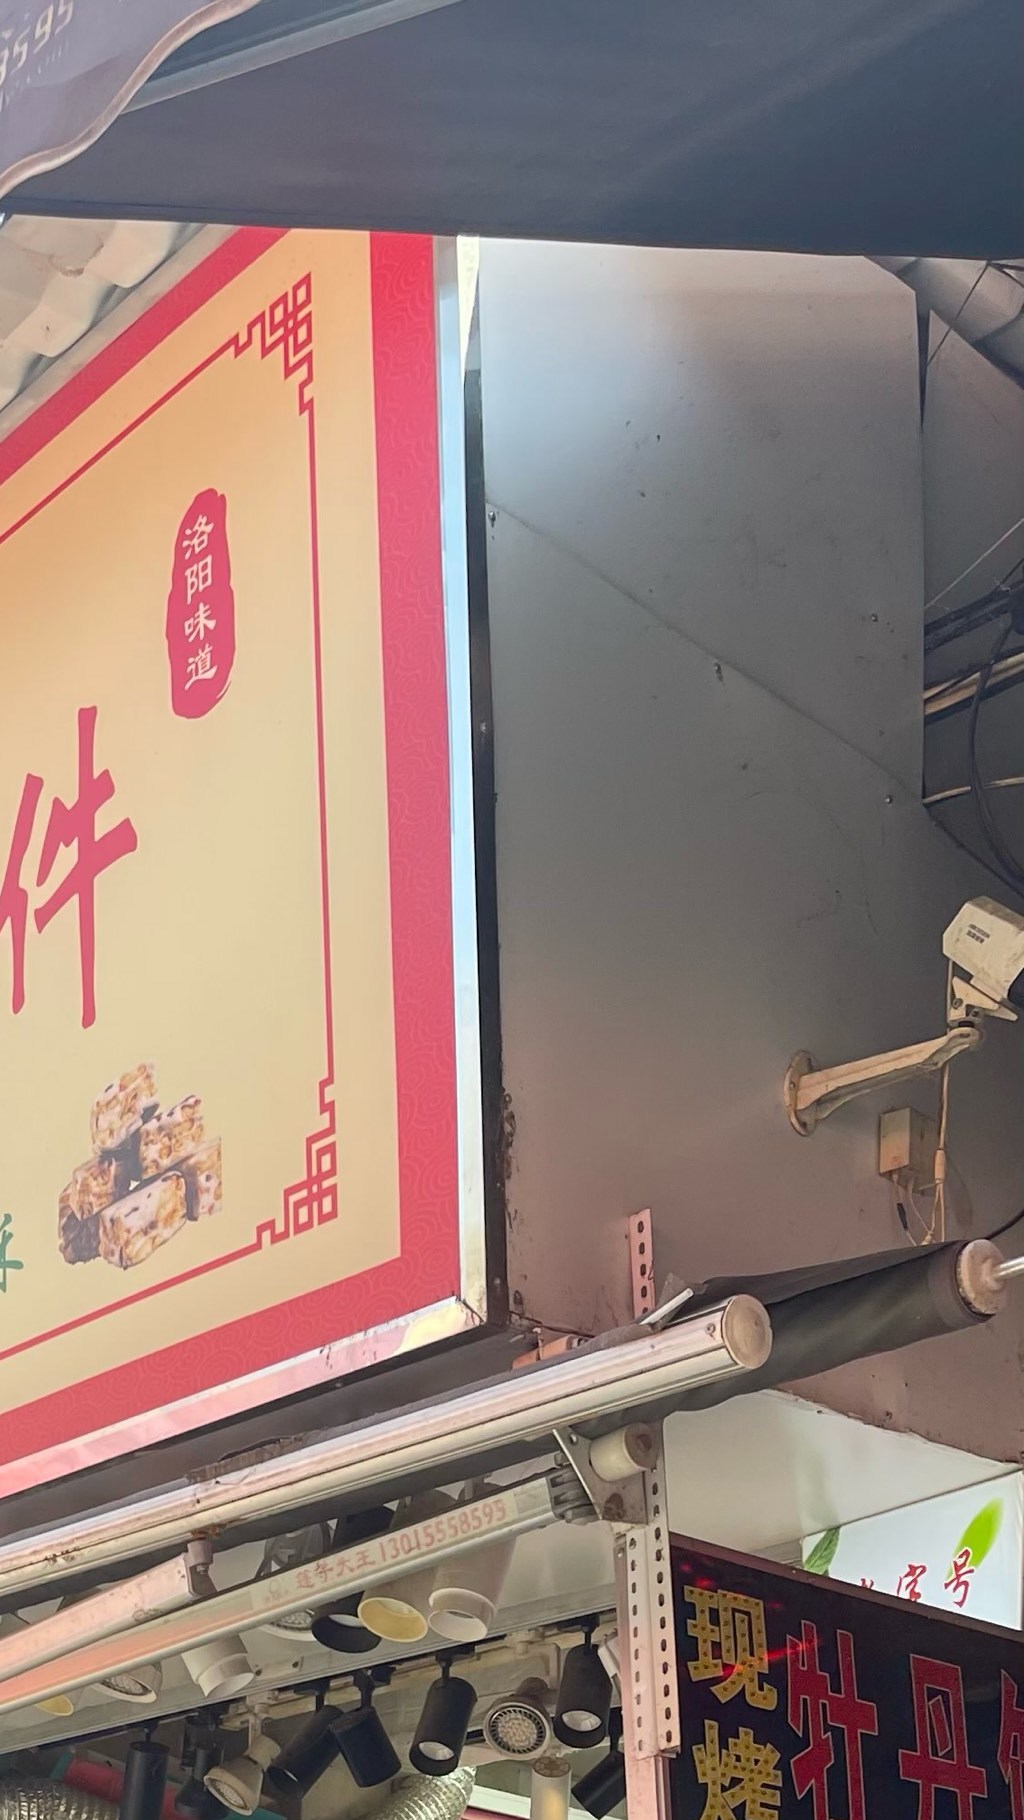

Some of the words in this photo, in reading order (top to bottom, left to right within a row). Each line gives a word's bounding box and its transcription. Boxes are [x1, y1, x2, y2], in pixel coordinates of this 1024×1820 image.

[182, 513, 220, 692] 洛阳味道
[378, 1498, 509, 1563] 13015558595
[860, 1548, 975, 1608] 字号
